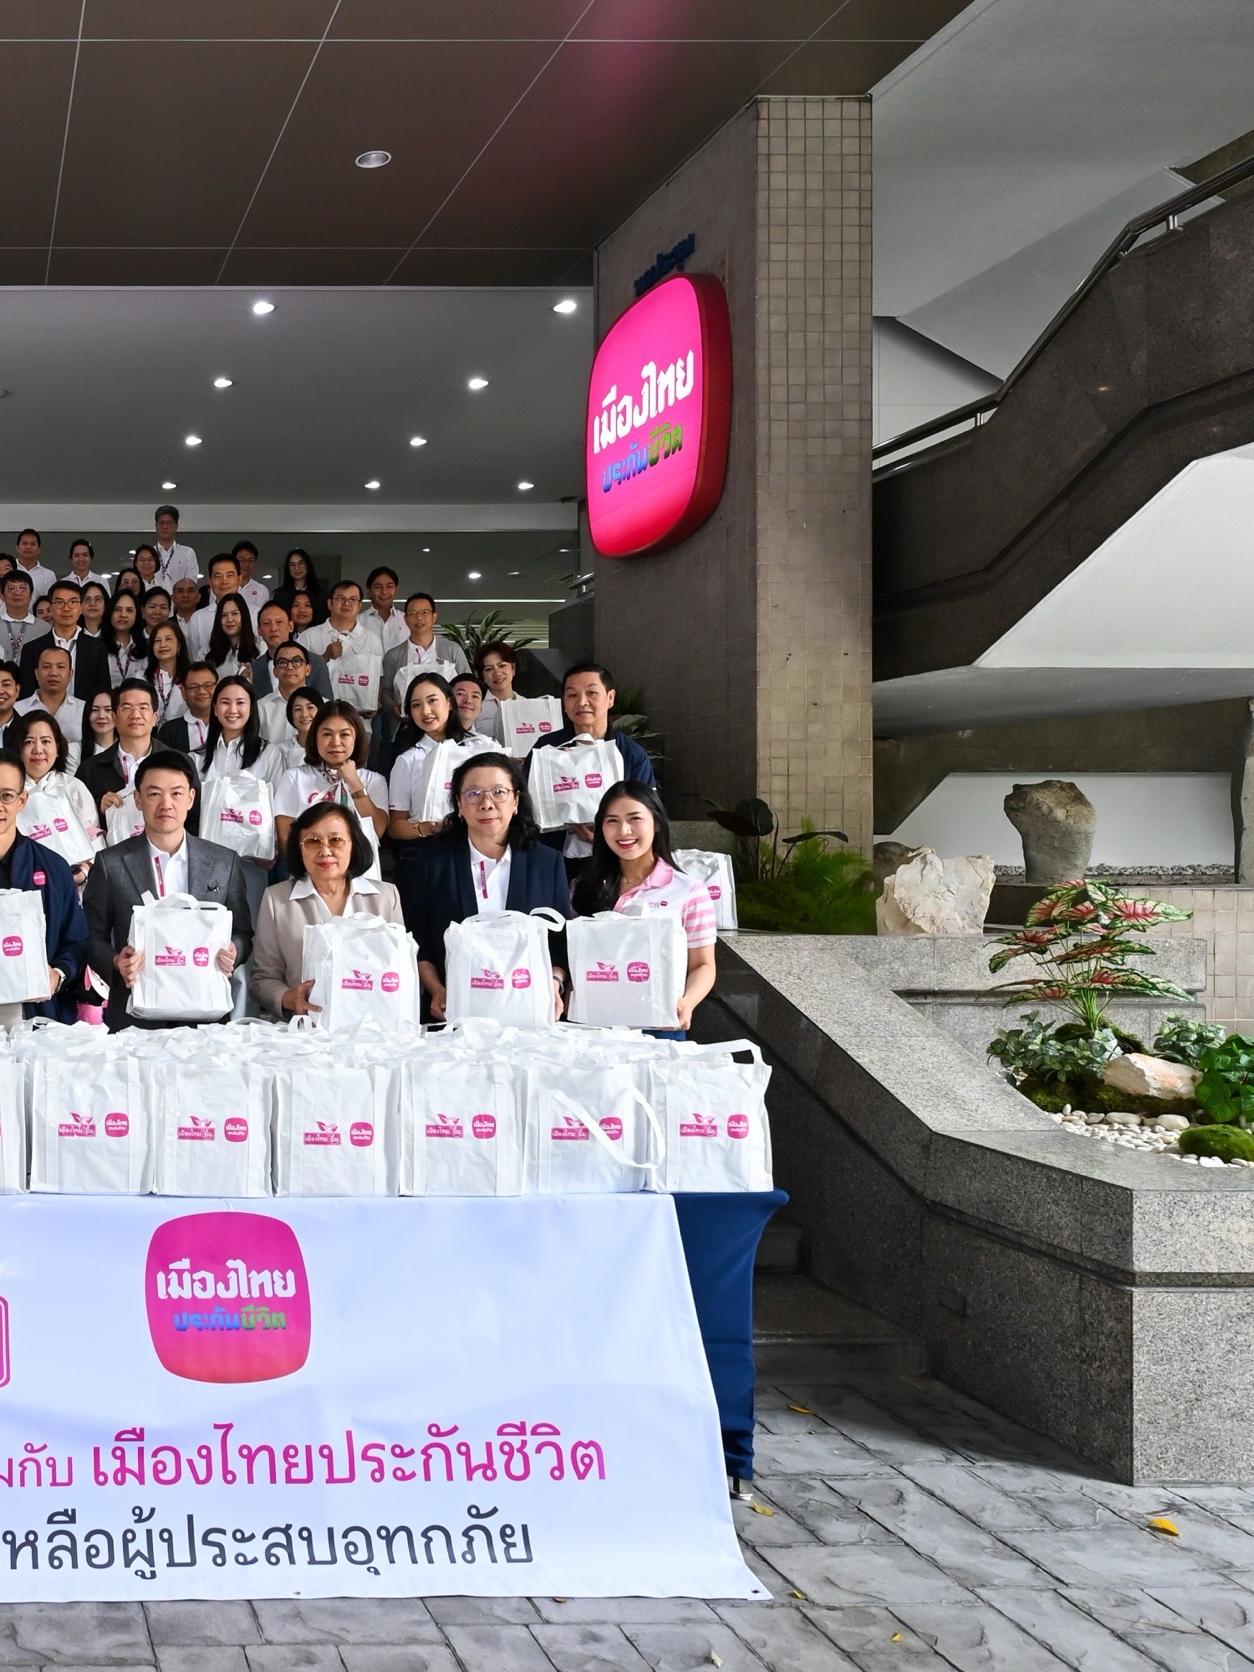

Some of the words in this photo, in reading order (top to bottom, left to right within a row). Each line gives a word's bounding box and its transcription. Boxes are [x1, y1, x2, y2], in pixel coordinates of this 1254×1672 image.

[593, 350, 695, 454] เมืองไทย
[602, 423, 683, 493] ประกันชีวิต
[157, 1258, 296, 1299] เมืองไทย
[173, 1304, 287, 1331] ประกันชีวิต
[92, 1421, 606, 1487] เมืองไทยประกันชีวิต
